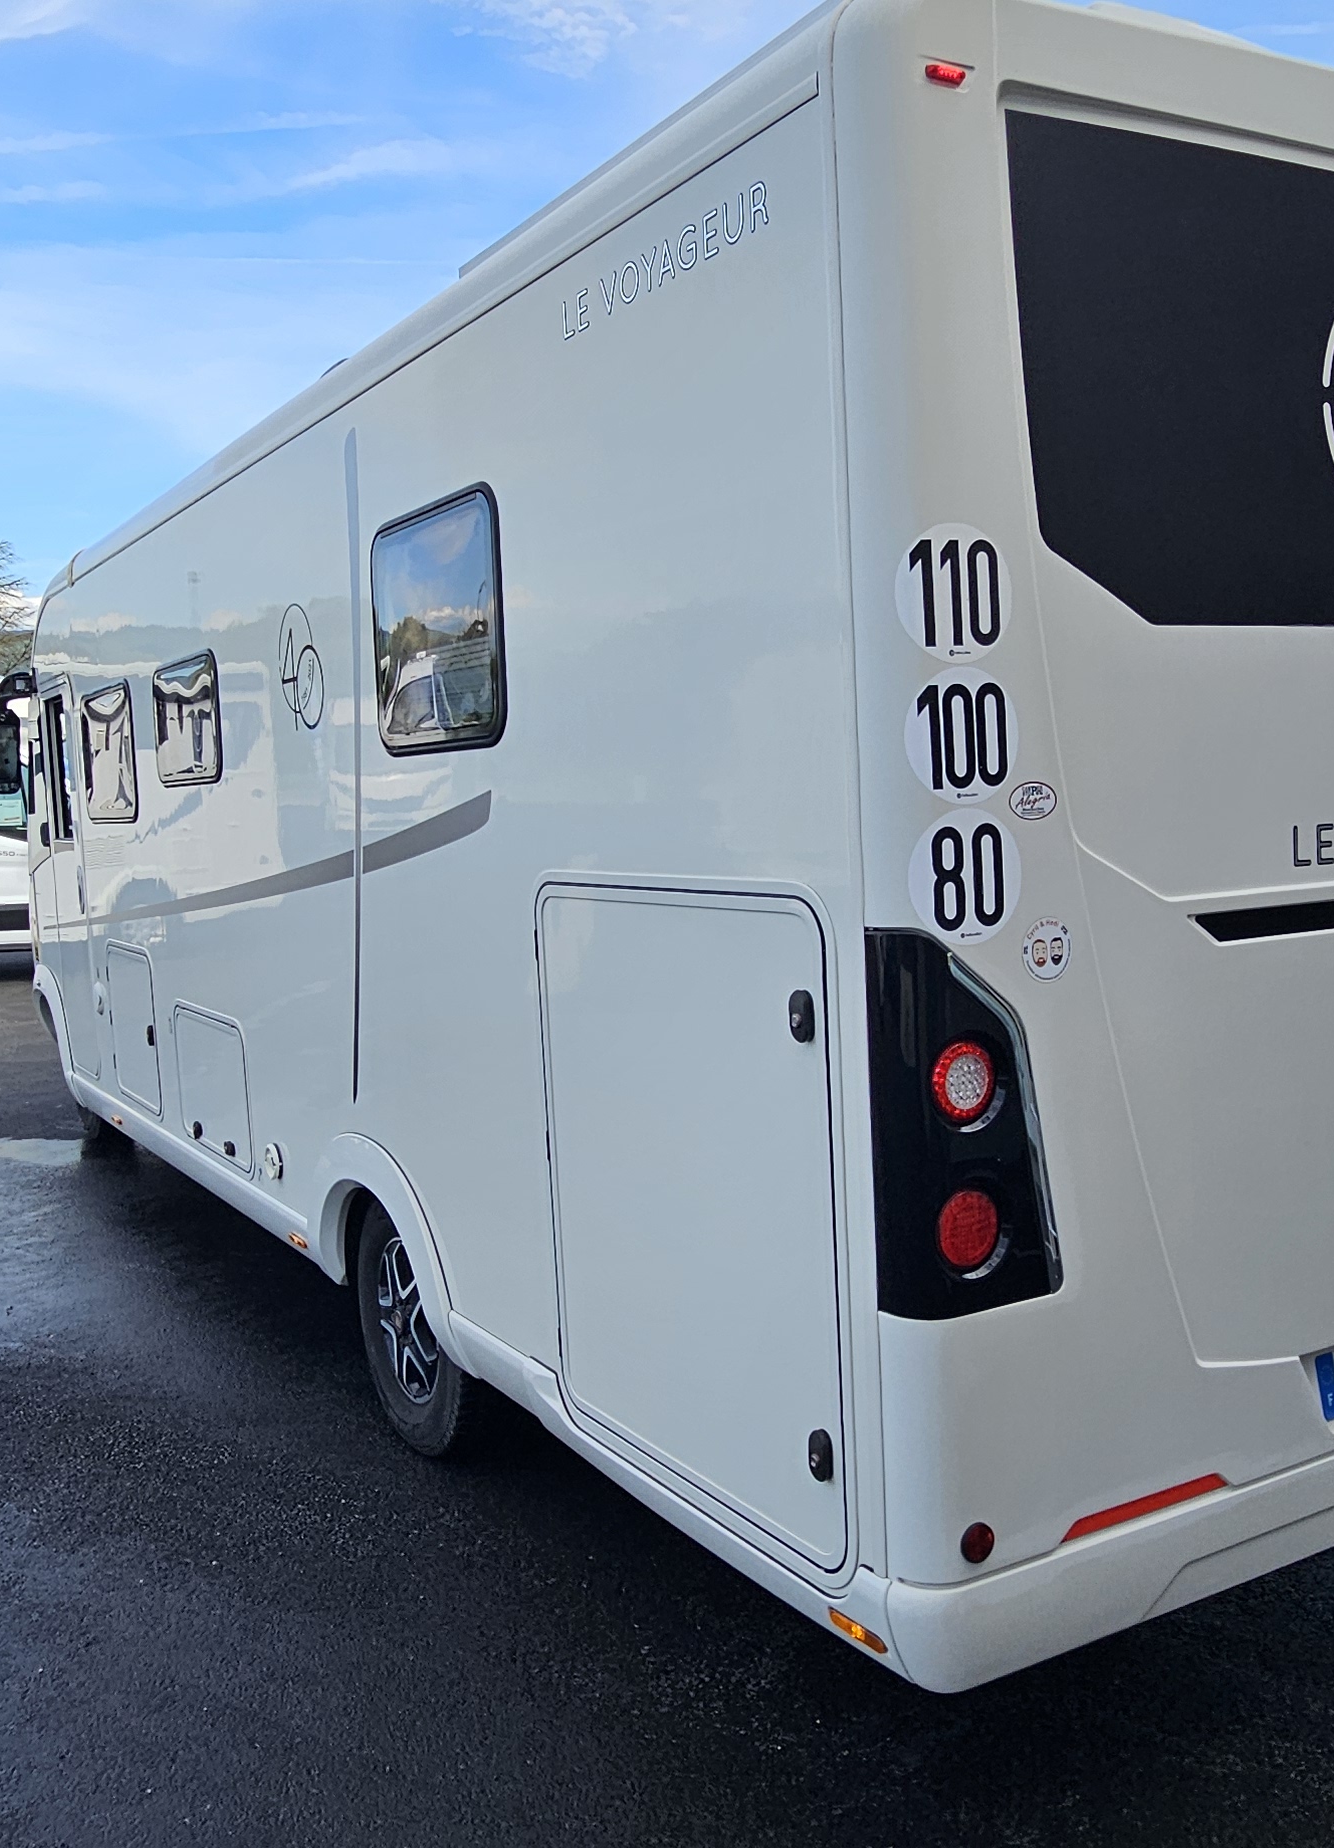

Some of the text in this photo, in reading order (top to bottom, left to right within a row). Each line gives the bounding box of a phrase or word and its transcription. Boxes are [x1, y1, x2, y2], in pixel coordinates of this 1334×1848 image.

[562, 181, 769, 341] LE VOYAGEUR
[909, 539, 1001, 647] 110
[917, 682, 1008, 790] 100
[931, 822, 1005, 932] 80
[1292, 823, 1334, 867] LE
